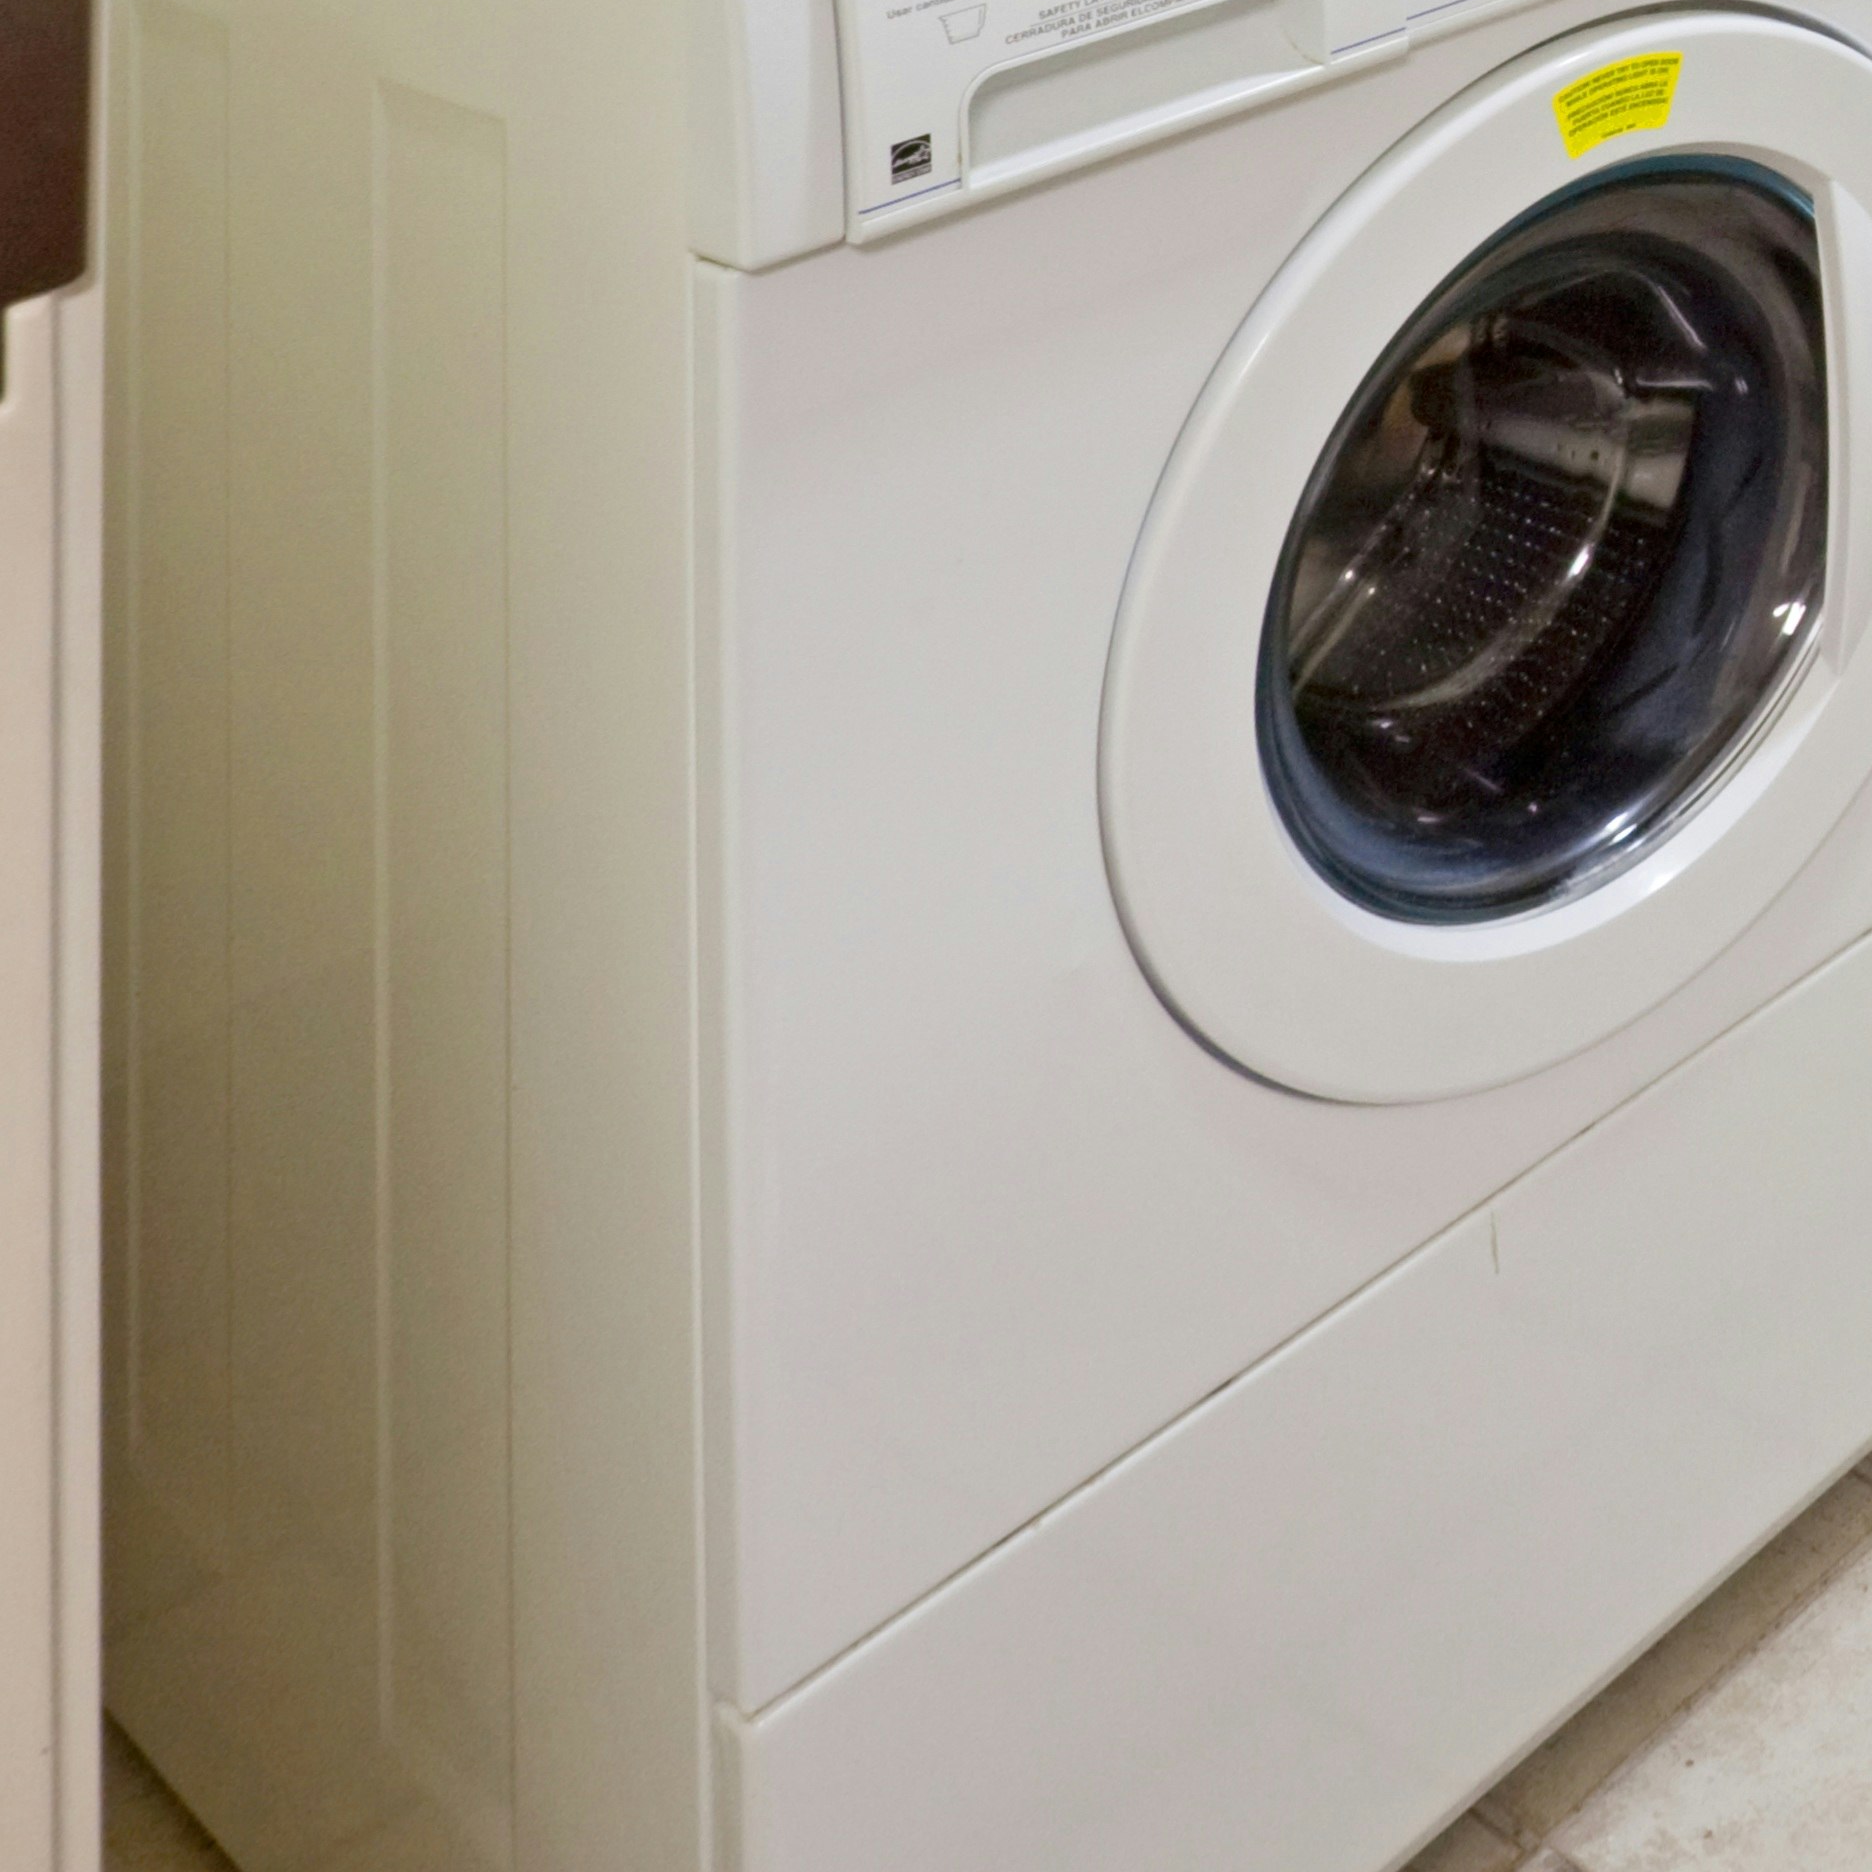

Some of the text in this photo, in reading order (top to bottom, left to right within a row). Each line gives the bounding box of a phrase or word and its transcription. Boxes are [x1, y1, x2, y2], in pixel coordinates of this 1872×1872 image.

[887, 6, 912, 19] Usar
[1061, 22, 1092, 38] PARA
[1095, 10, 1128, 29] ABRIR
[1005, 16, 1075, 45] CERRADURA
[1079, 10, 1093, 23] DE
